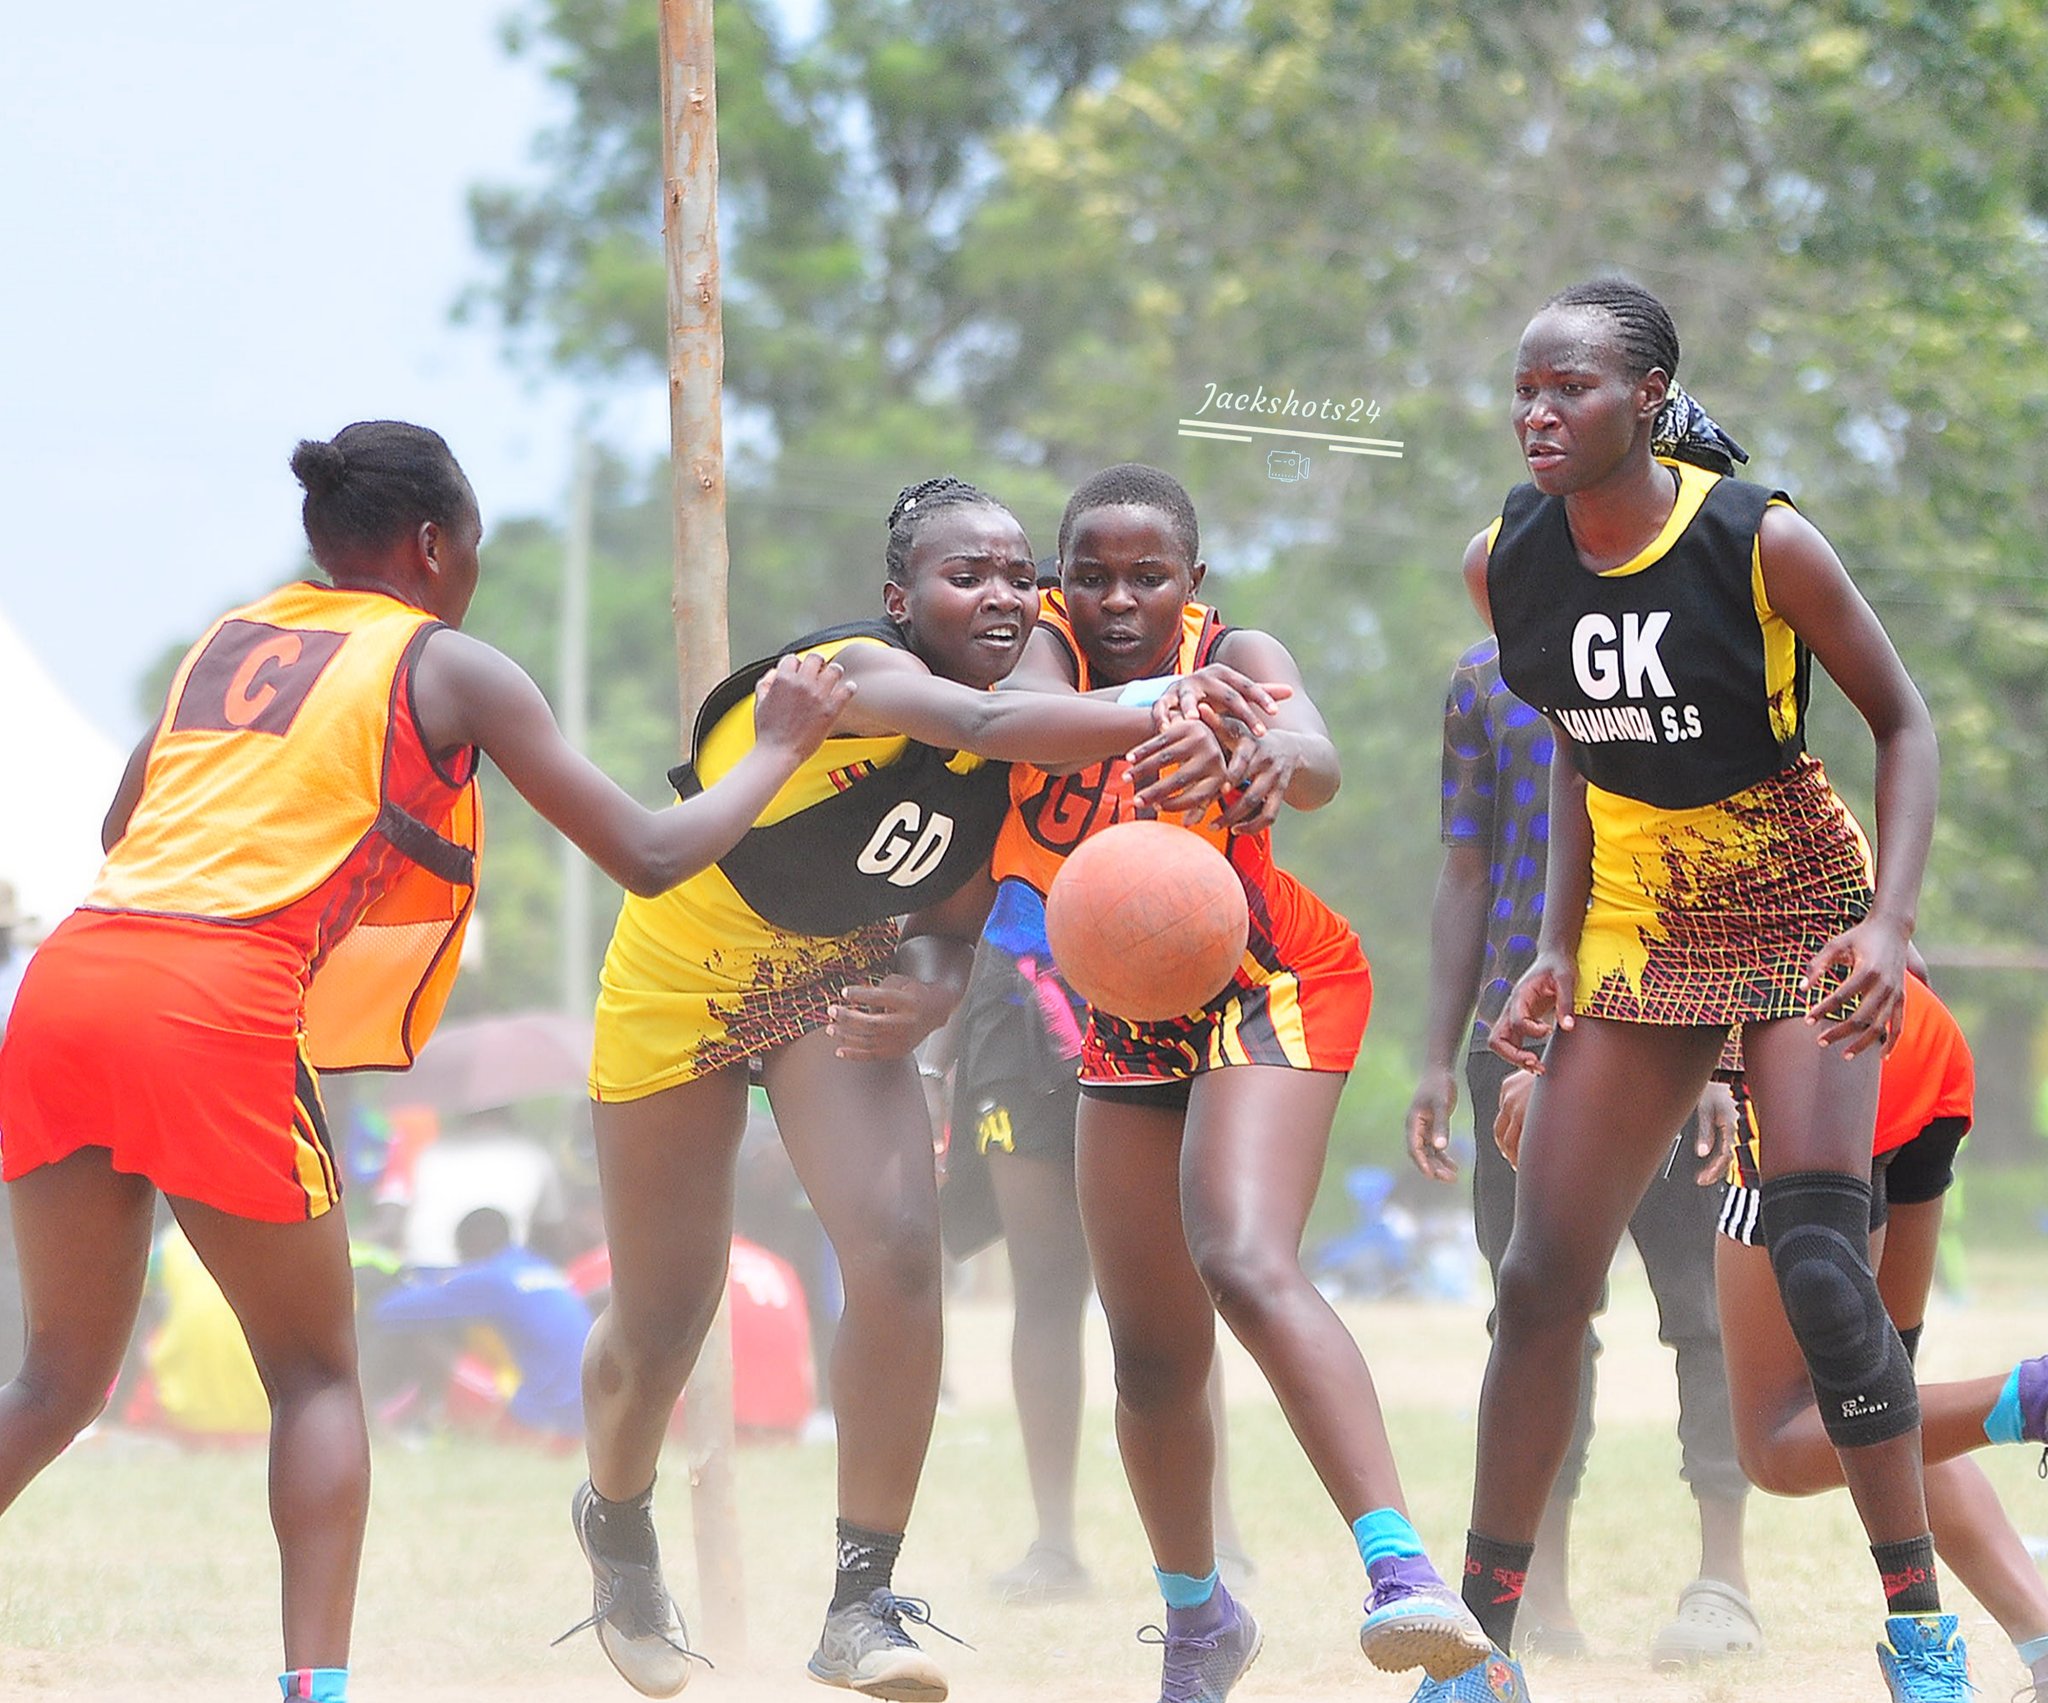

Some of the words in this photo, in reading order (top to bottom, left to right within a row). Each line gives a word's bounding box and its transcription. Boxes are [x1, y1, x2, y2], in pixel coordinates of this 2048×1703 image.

[224, 634, 303, 726] C
[1571, 610, 1677, 701] GK
[1660, 704, 1703, 743] S.S
[856, 801, 954, 888] GD
